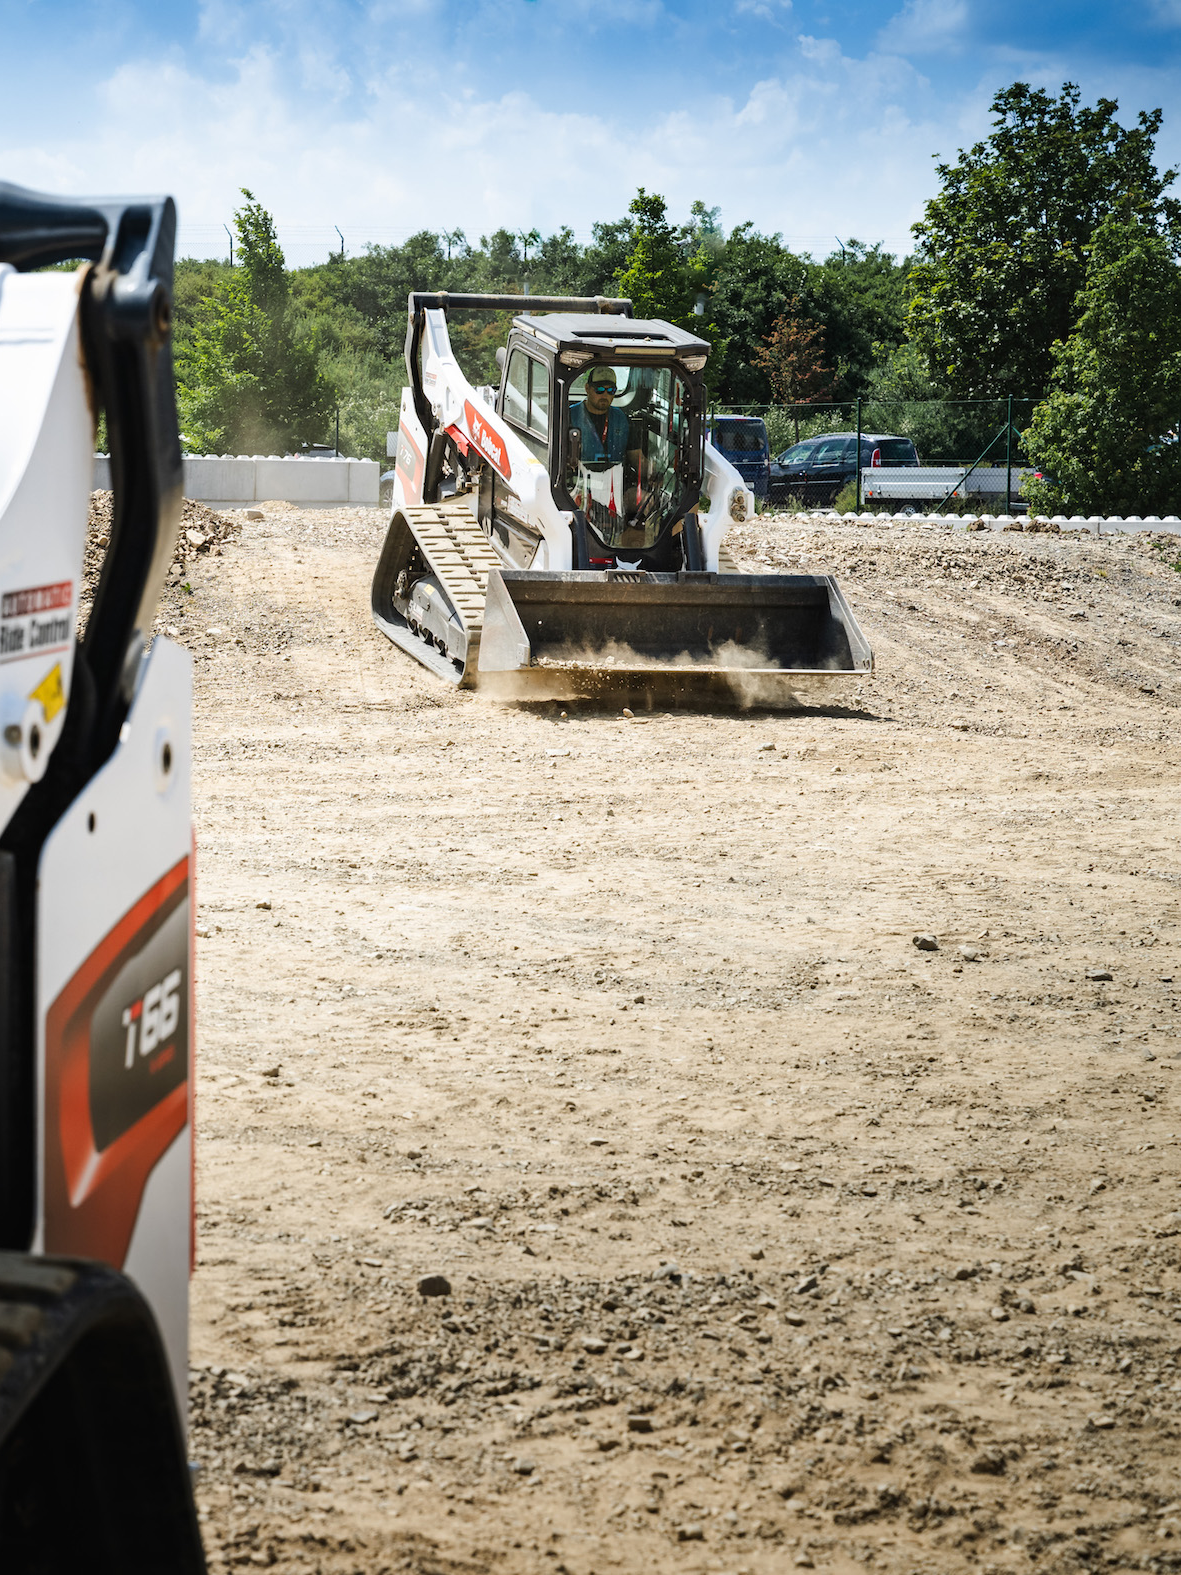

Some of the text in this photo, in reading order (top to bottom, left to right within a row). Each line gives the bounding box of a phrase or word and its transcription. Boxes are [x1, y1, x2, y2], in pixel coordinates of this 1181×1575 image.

[400, 444, 412, 465] T76
[0, 616, 70, 654] Ride Control
[122, 968, 182, 1070] T66
